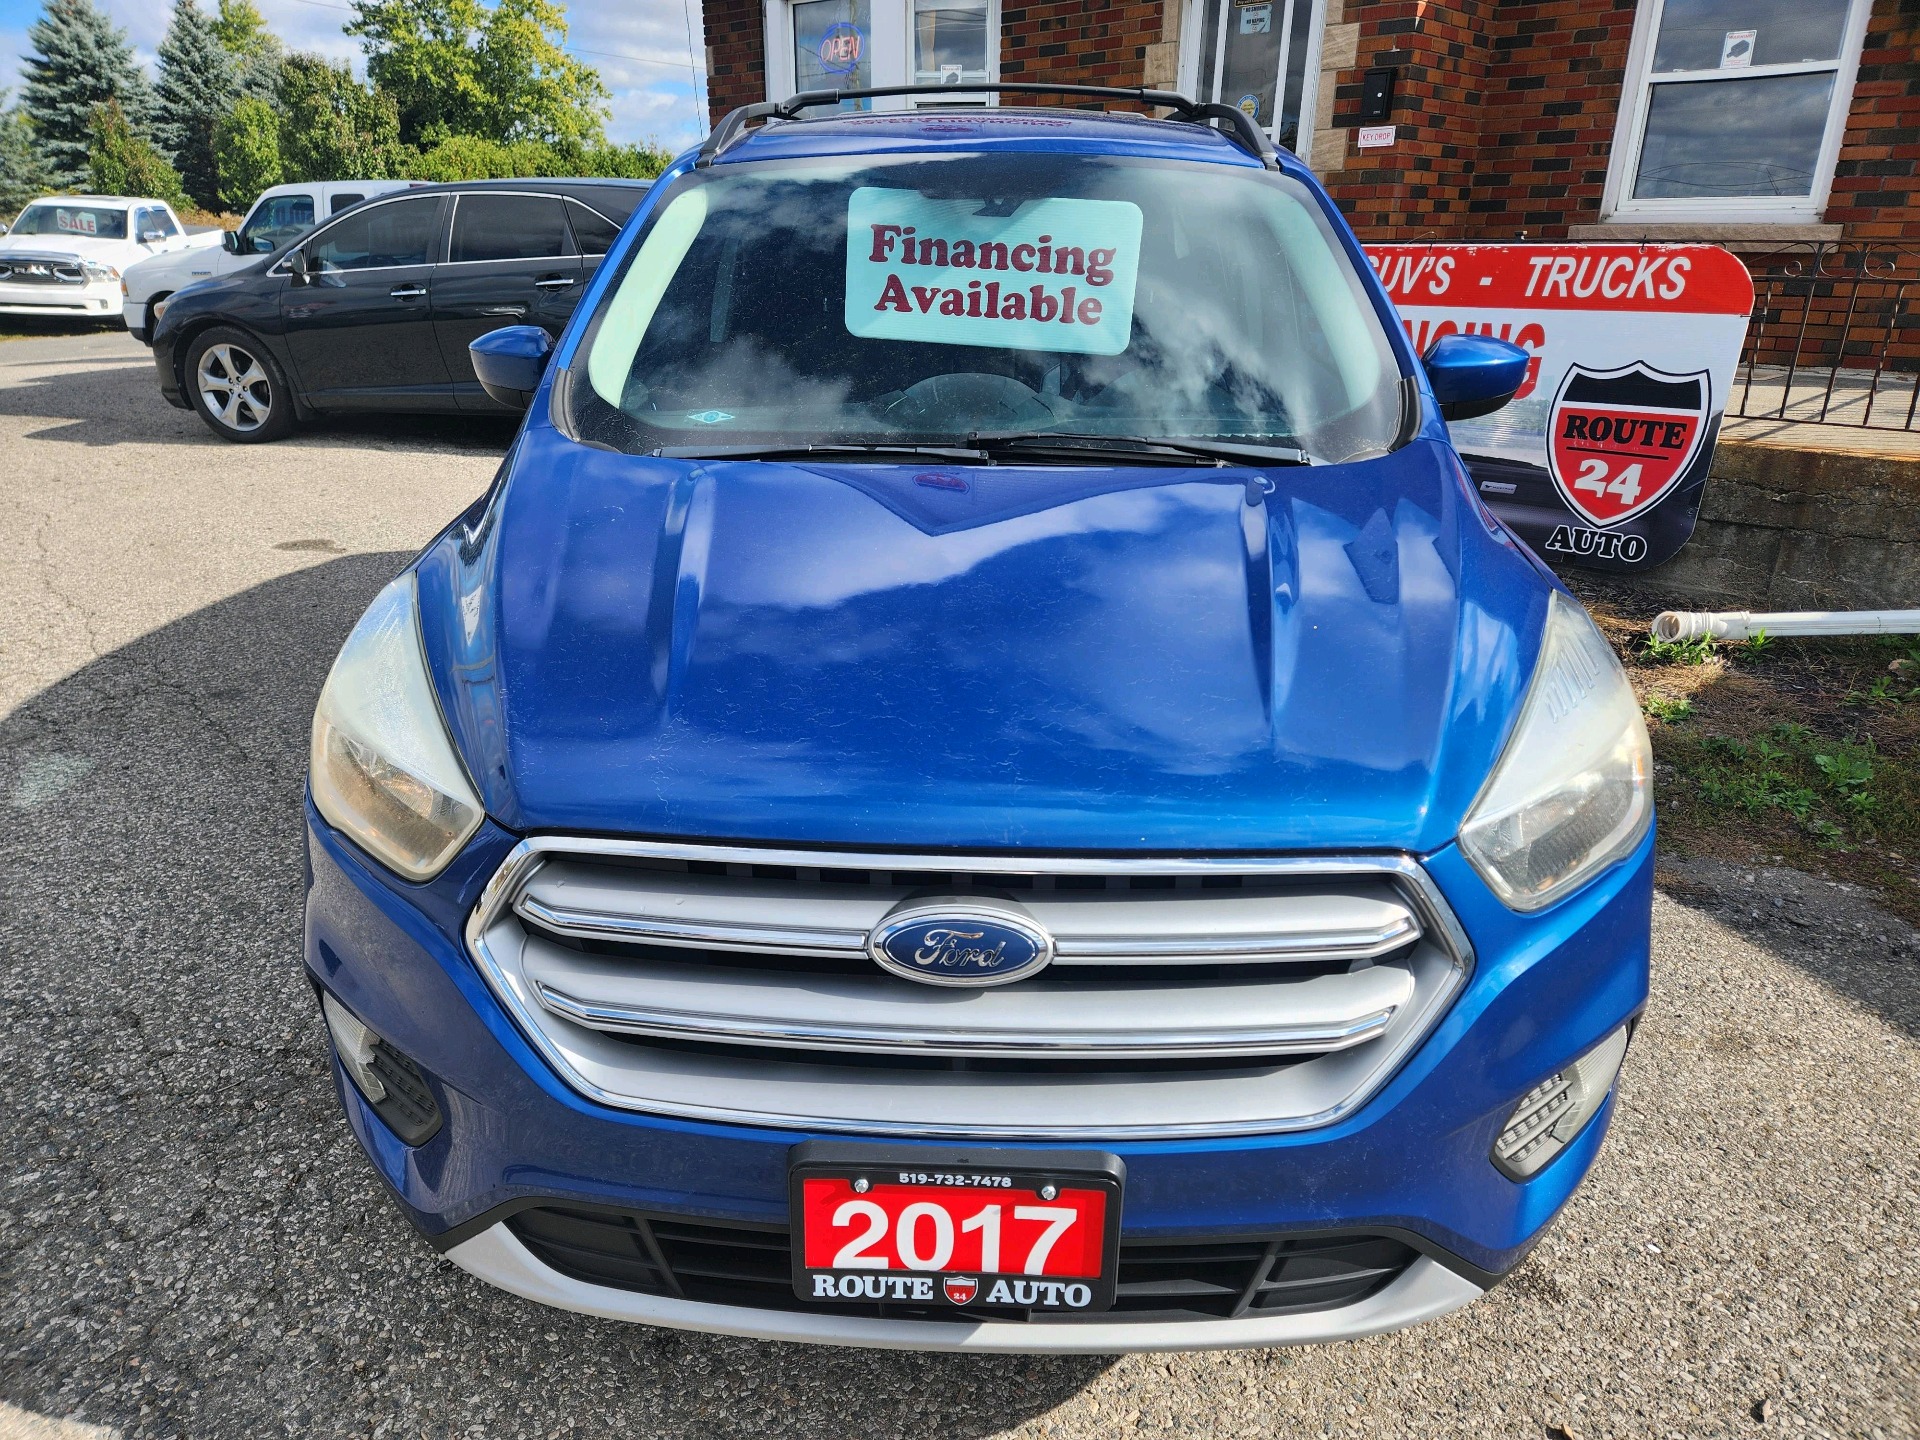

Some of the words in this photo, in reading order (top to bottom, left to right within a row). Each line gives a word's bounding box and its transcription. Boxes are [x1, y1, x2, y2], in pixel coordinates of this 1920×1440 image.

[820, 36, 860, 61] OPEN
[1375, 132, 1391, 140] DROP
[60, 215, 95, 232] SALE
[868, 223, 1117, 286] Financing
[1524, 256, 1691, 300] TRUCKS
[874, 274, 1104, 326] Available
[1562, 415, 1687, 449] ROUTE
[1574, 458, 1643, 505] 24
[1545, 524, 1648, 563] AUTO
[914, 928, 1005, 968] Ford
[899, 1173, 1012, 1188] 519-732-7478
[832, 1200, 1078, 1276] 2017
[812, 1275, 934, 1300] ROUTE
[953, 1292, 967, 1301] 24
[985, 1279, 1092, 1308] AUTO
